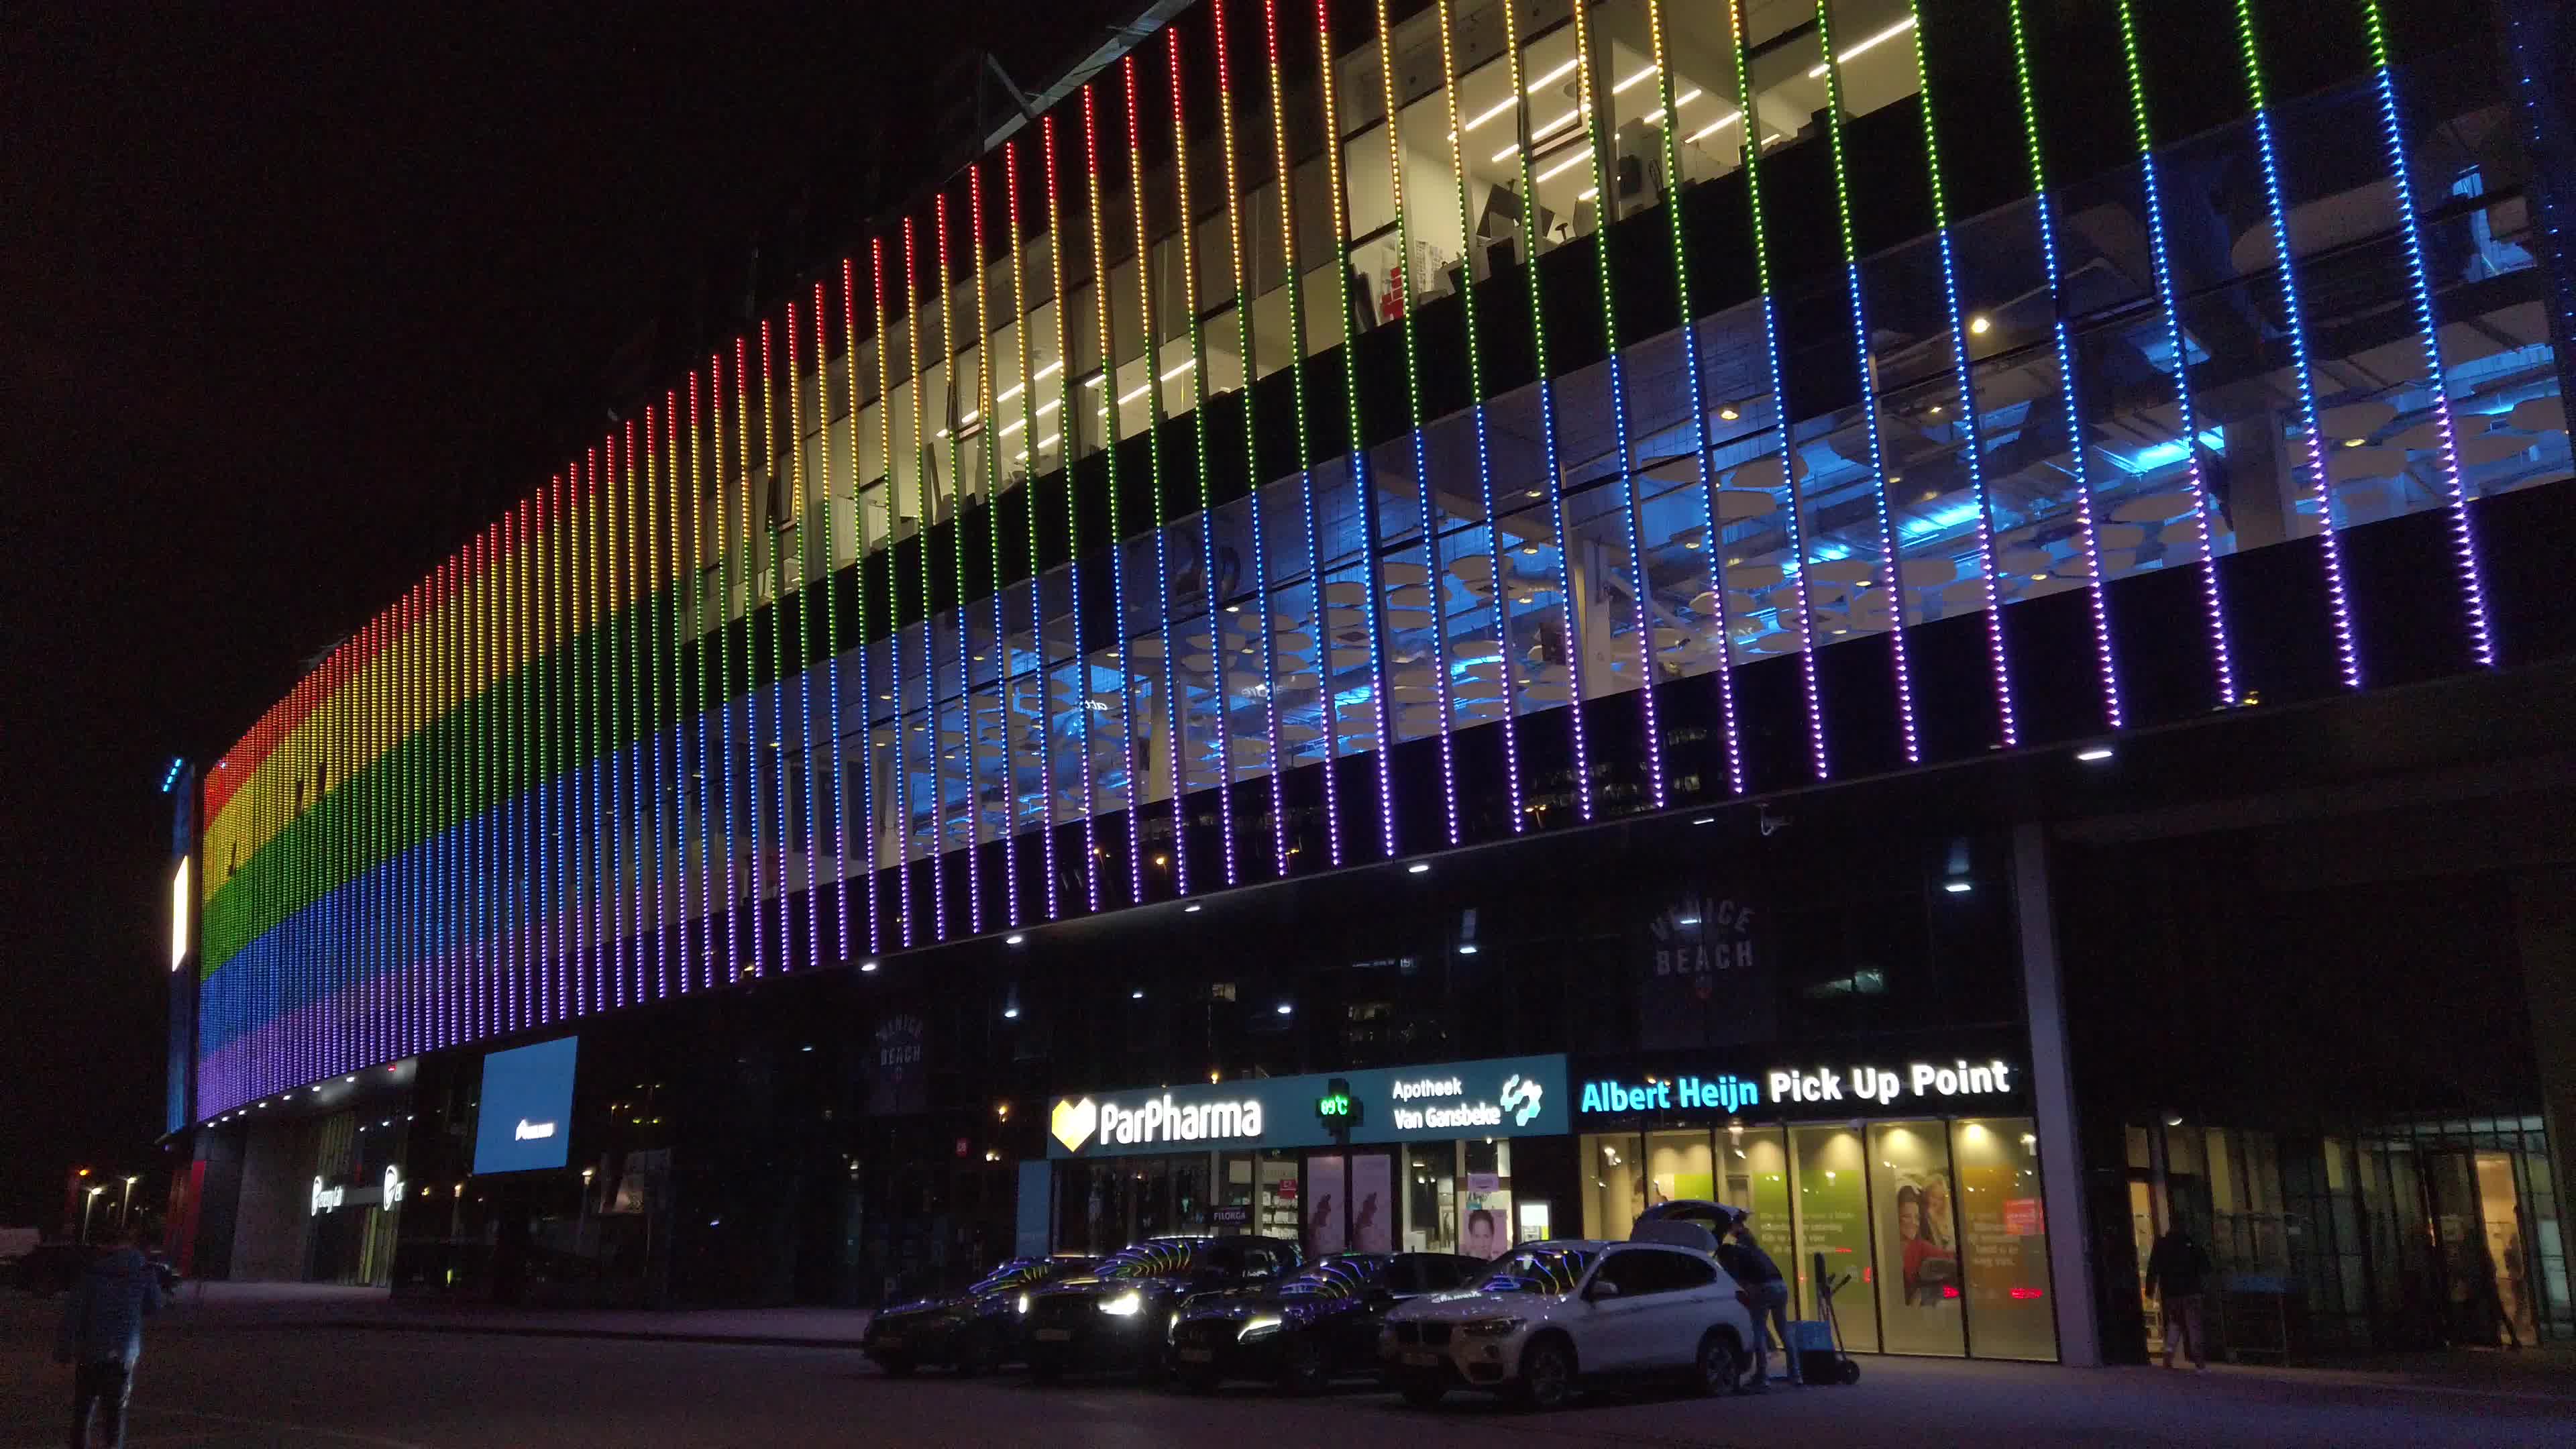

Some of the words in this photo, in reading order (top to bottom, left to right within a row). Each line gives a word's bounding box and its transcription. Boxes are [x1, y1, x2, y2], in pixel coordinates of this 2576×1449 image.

[1656, 941, 1753, 976] BEACH
[1393, 1077, 1462, 1102] Apotheek
[1581, 1081, 1671, 1113] Albert
[1679, 1075, 1759, 1114] Heijn
[1770, 1067, 1843, 1104] Pick
[1852, 1067, 1900, 1106] Up
[1912, 1059, 2010, 1097] Point
[1100, 1093, 1262, 1145] ParPharma
[1394, 1108, 1424, 1130] Van
[1425, 1102, 1501, 1128] Gansbeke
